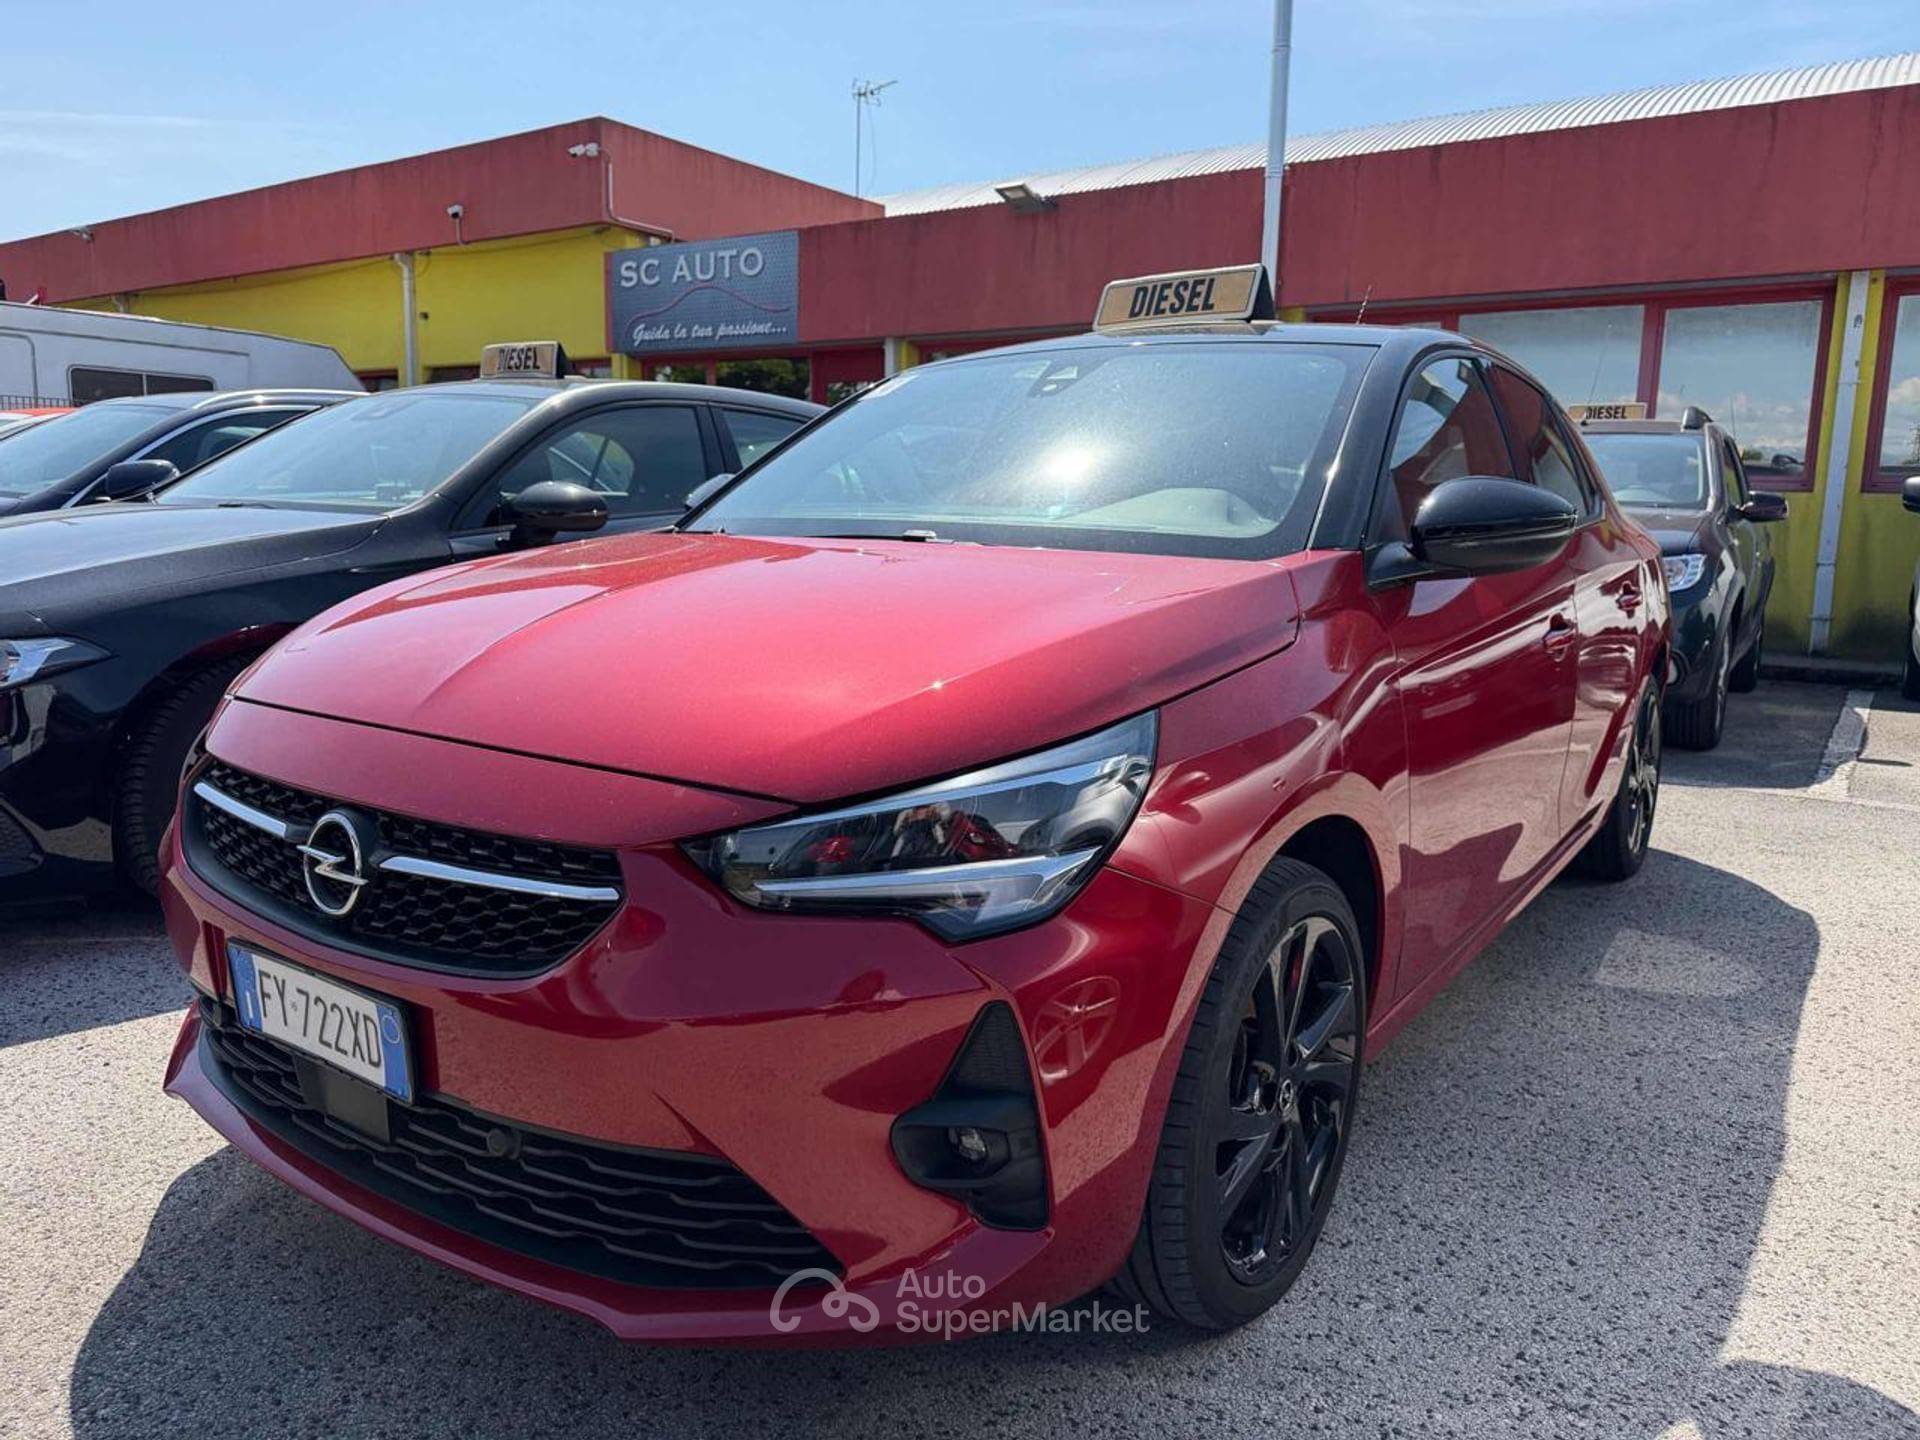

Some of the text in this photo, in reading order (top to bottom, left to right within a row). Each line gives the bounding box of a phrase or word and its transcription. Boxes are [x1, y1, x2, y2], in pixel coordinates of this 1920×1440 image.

[620, 247, 764, 288] SC AUTO
[1128, 277, 1216, 319] DIESEL
[633, 319, 787, 347] Guida la tua passione...
[497, 346, 541, 371] DIESEL
[1585, 405, 1628, 420] DIESEL
